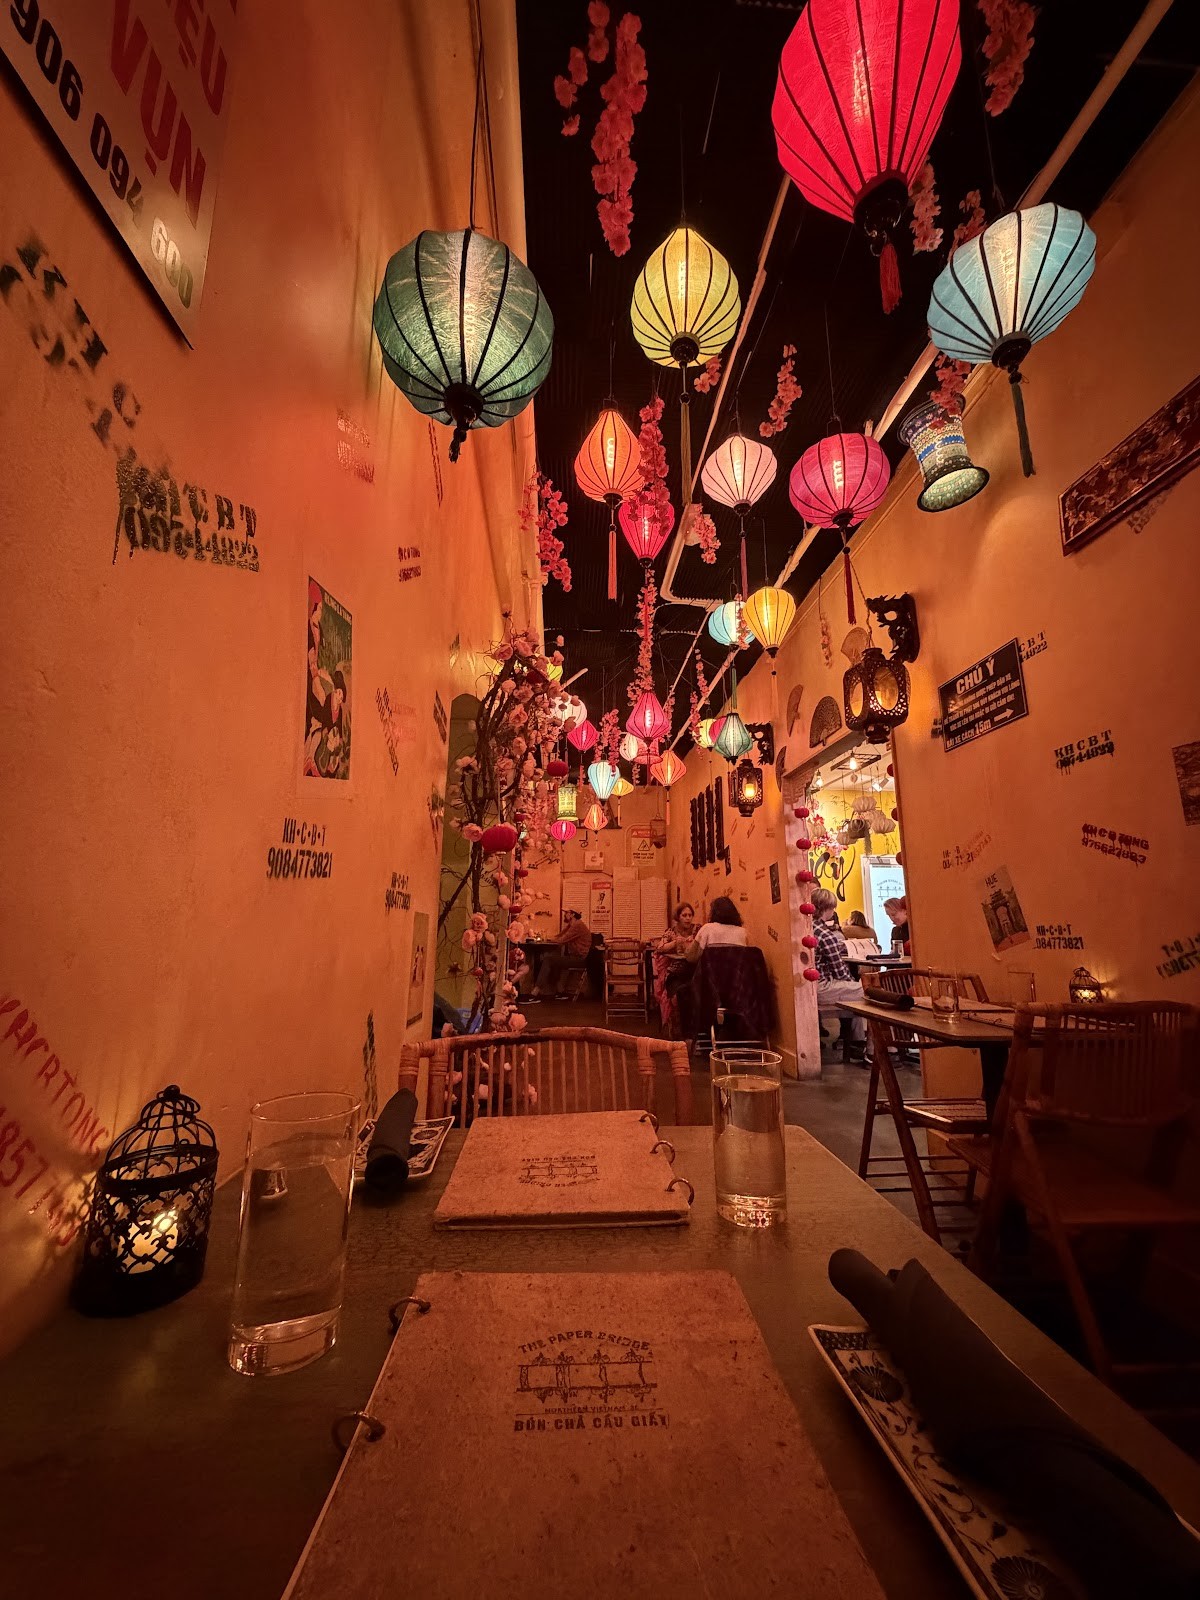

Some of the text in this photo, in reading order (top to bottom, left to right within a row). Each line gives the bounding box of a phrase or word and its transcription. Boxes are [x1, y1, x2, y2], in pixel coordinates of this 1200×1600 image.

[956, 657, 996, 695] CHÚ Ý
[974, 718, 991, 734] 15m
[1032, 936, 1084, 950] 084773821
[518, 1339, 546, 1354] THE
[549, 1330, 594, 1345] PAPER
